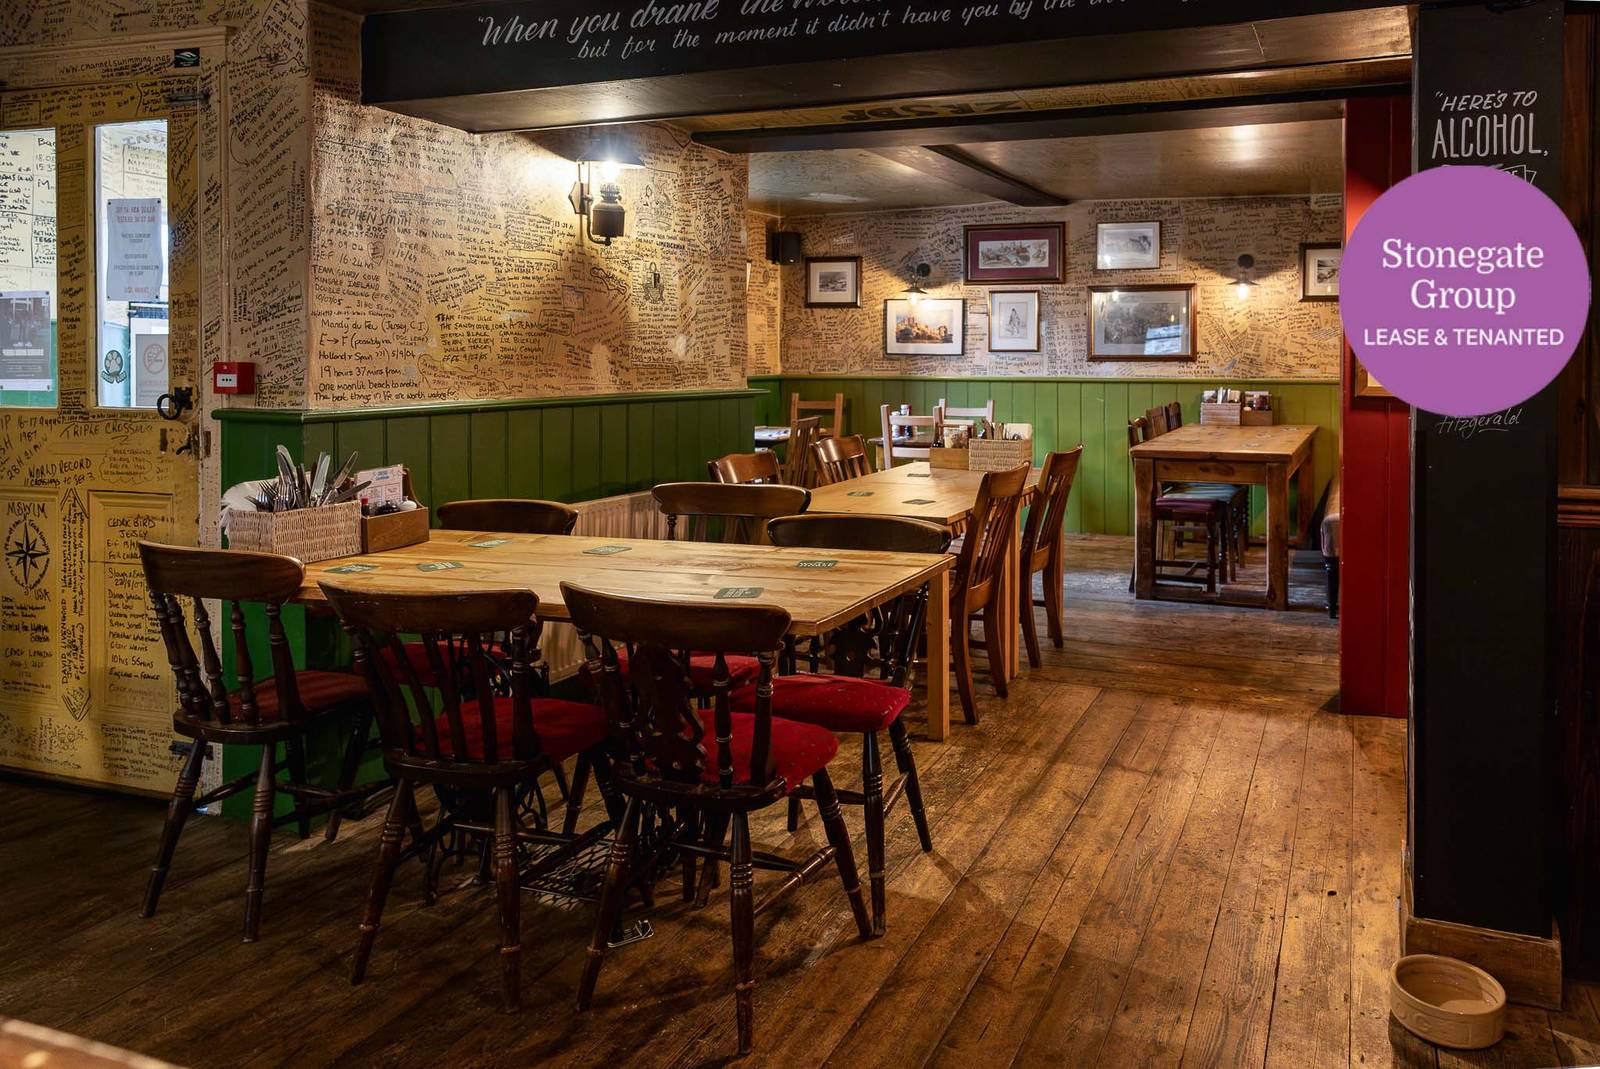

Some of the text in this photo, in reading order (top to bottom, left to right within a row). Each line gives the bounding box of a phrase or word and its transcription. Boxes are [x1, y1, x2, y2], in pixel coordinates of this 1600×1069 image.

[566, 11, 620, 44] you
[630, 0, 720, 28] drank
[578, 39, 610, 58] but
[621, 36, 656, 60] for
[672, 29, 700, 48] the
[714, 18, 799, 44] moment
[805, 17, 820, 35] it
[828, 9, 891, 32] didn't
[902, 8, 951, 25] have
[961, 2, 999, 27] you
[1512, 90, 1538, 107] TO
[1431, 112, 1549, 159] ALCOHOL,
[59, 457, 92, 475] RECORD
